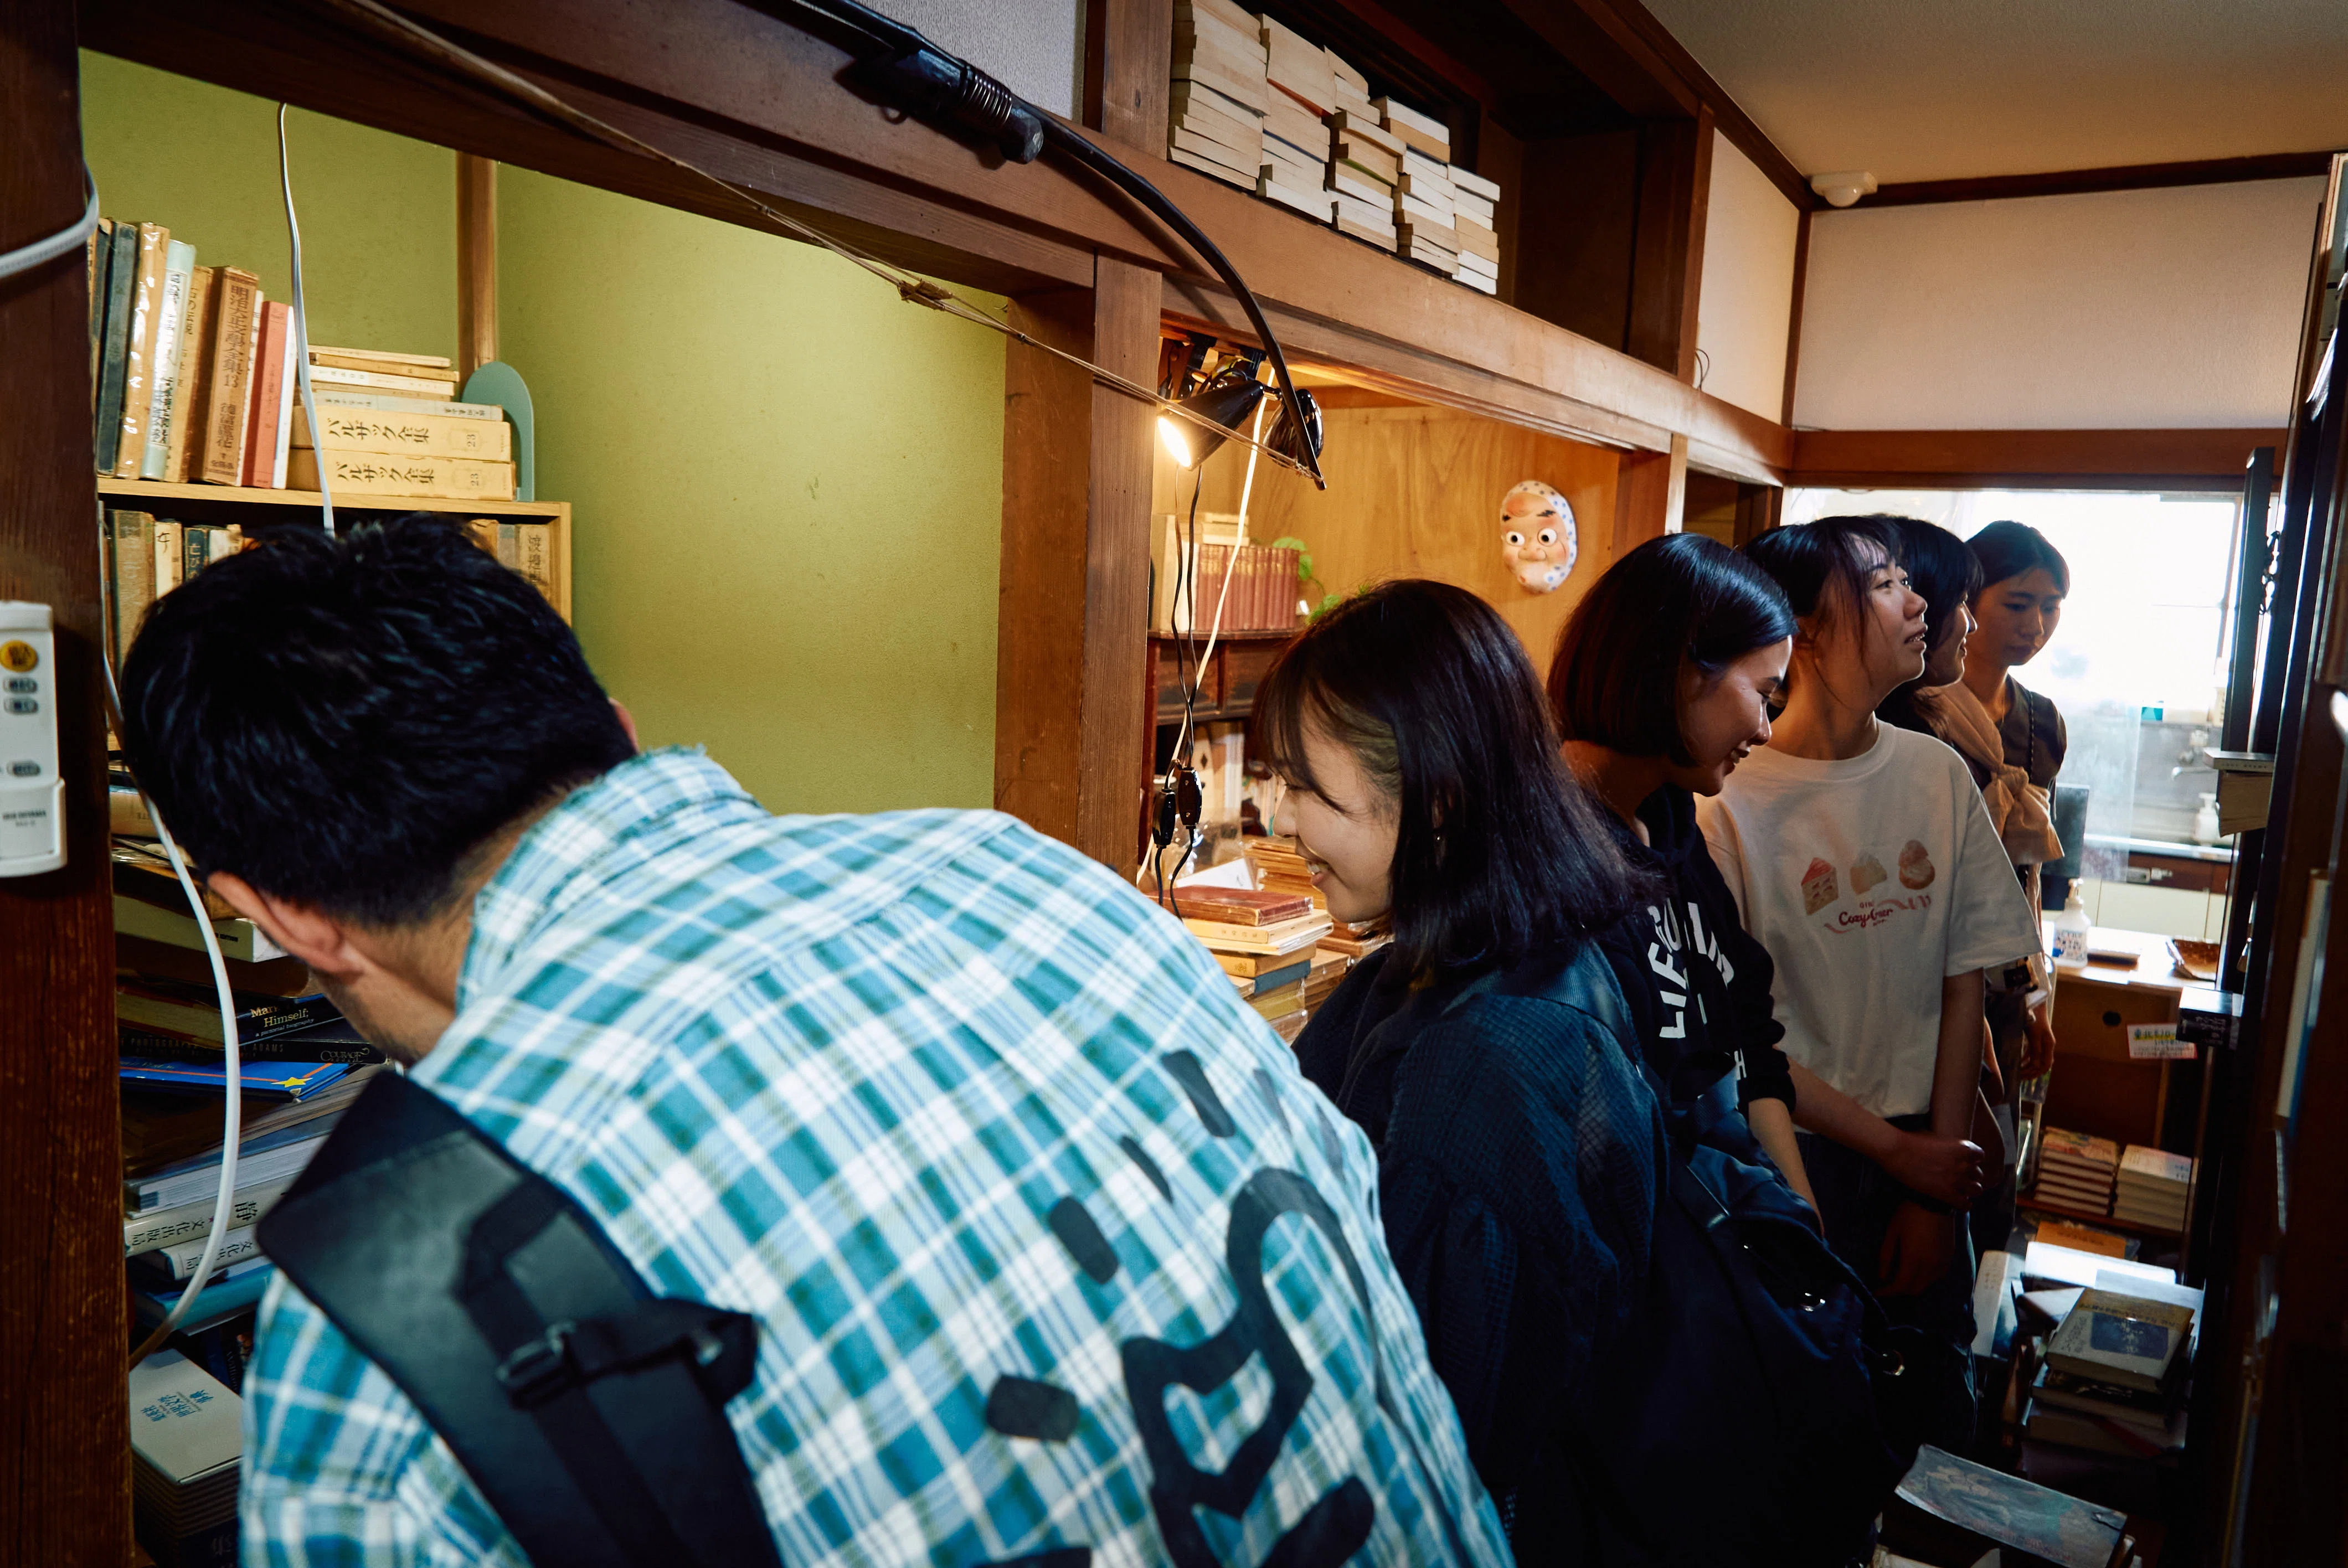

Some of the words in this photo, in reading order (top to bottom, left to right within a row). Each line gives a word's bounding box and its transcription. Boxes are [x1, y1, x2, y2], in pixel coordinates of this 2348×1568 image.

[327, 417, 430, 443] バルザック全集
[466, 434, 476, 447] 23
[336, 461, 435, 485] バルザック全集
[470, 473, 479, 487] 23
[1839, 910, 1870, 929] Cozy
[286, 1018, 315, 1029] biography
[131, 1219, 205, 1246] 文化出版局
